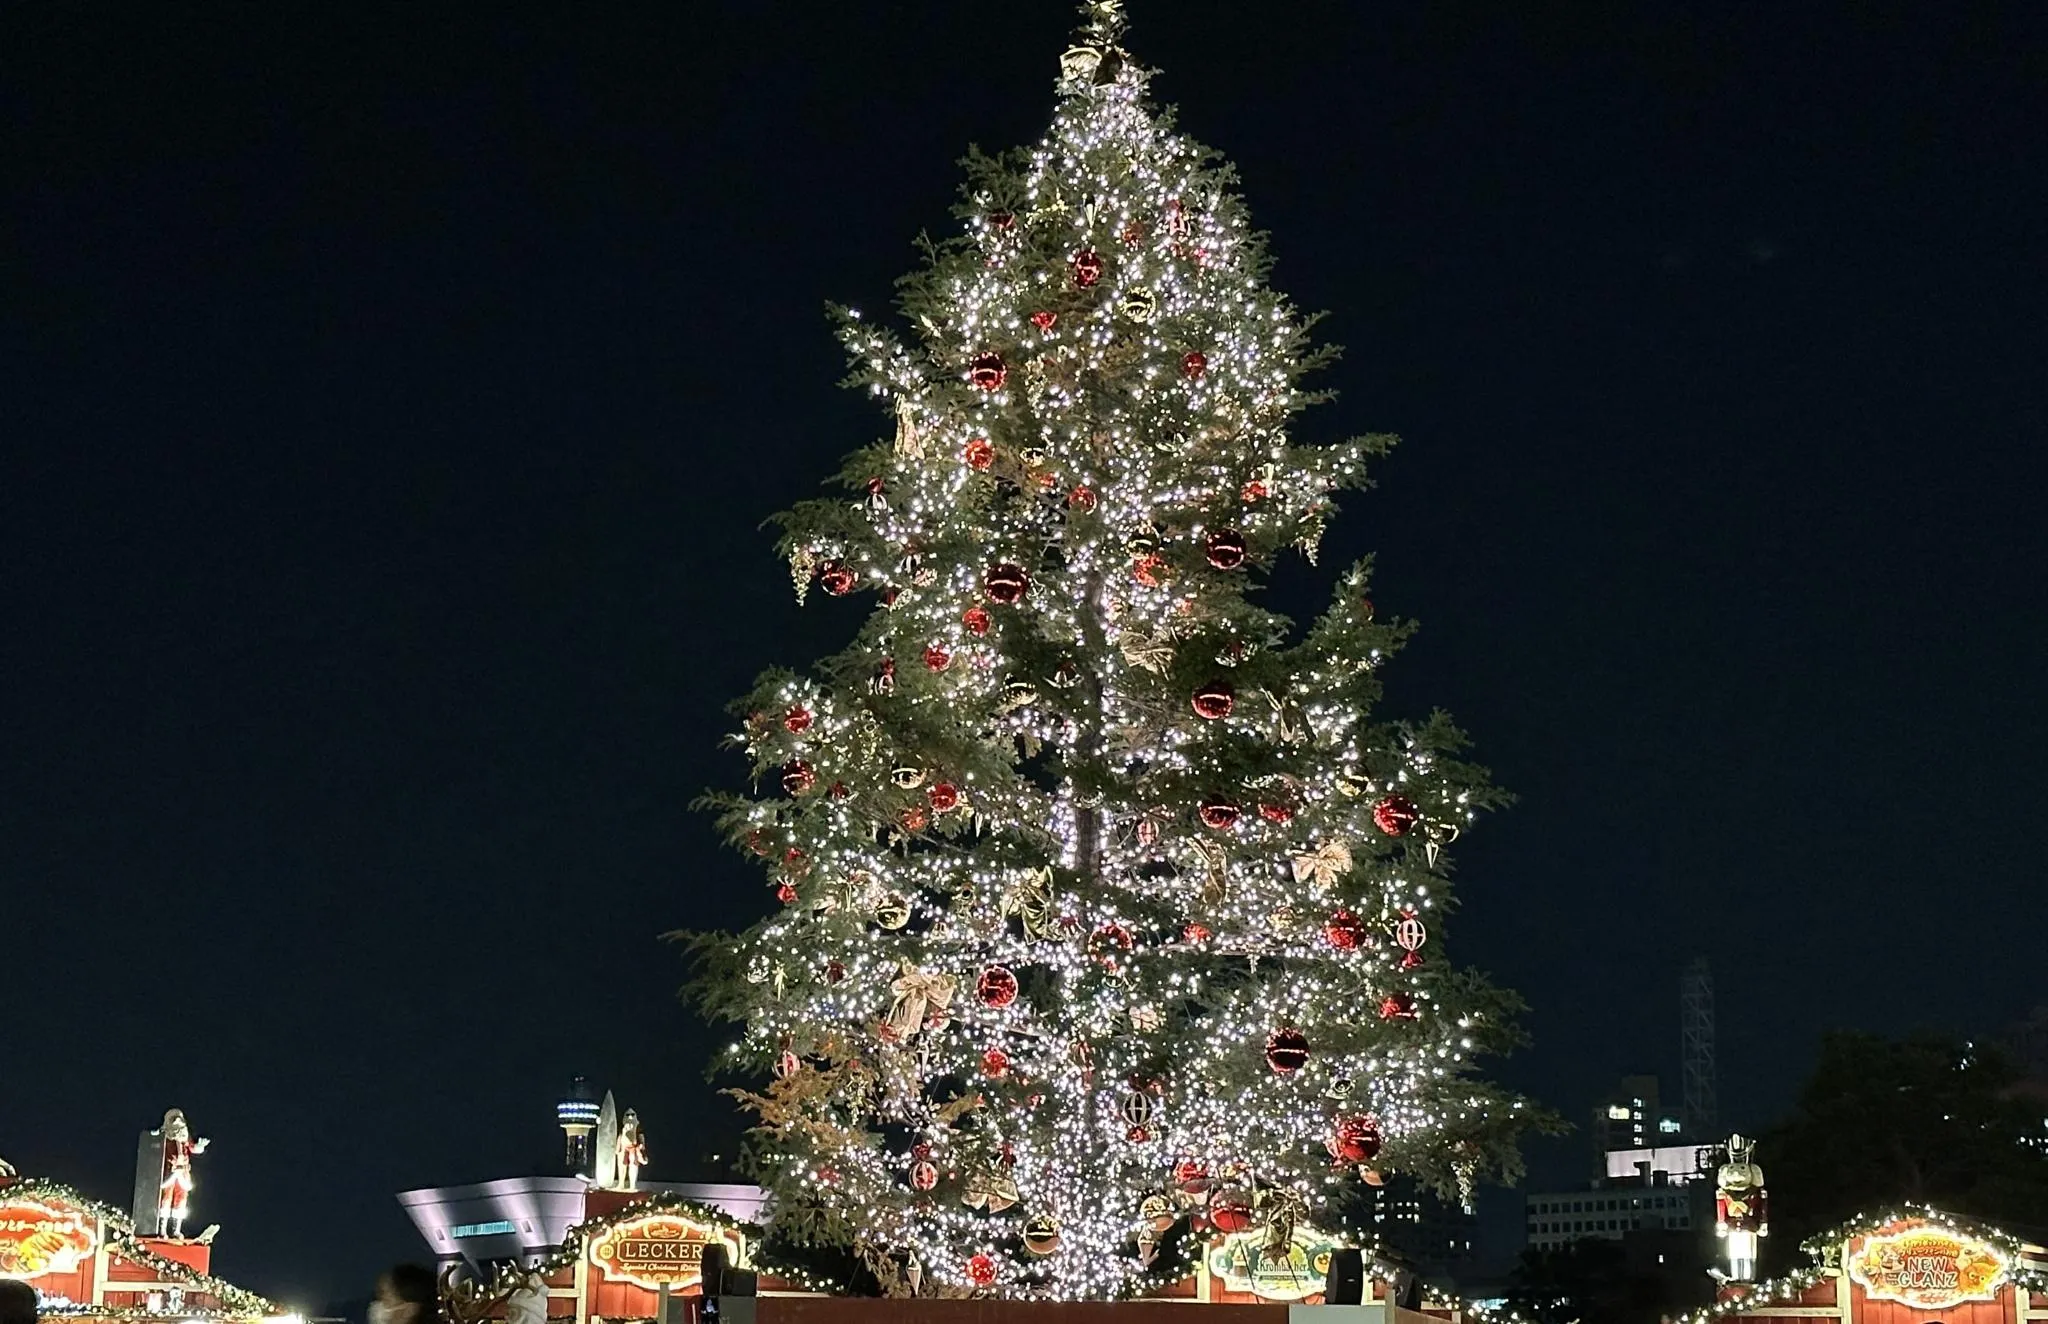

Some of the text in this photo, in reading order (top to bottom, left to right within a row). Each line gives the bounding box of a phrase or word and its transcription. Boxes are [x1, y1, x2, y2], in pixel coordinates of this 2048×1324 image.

[625, 1243, 702, 1258] LECKER
[1908, 1256, 1947, 1272] NEW
[1898, 1271, 1957, 1288] GLANZ
